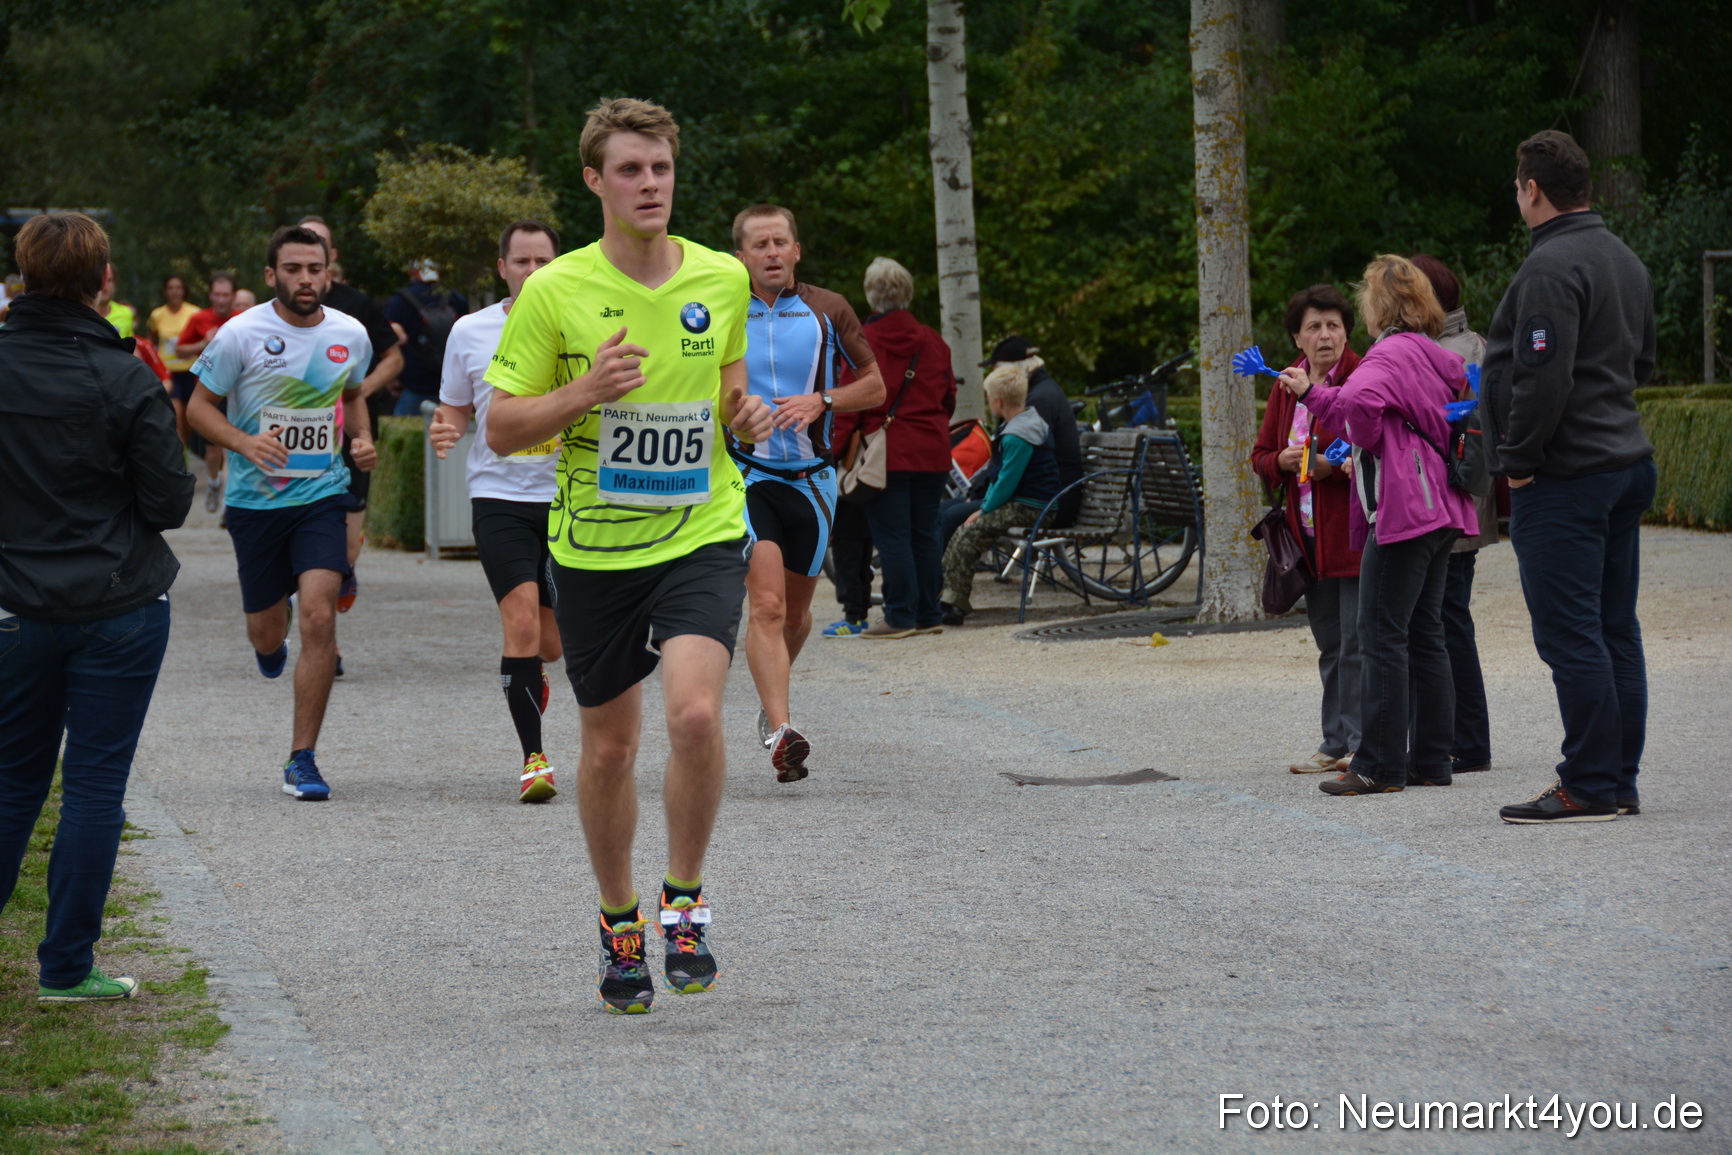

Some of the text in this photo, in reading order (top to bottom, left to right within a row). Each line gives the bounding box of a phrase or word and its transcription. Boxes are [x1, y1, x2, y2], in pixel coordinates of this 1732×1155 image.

[681, 337, 715, 350] Partl
[499, 355, 517, 371] Partl
[263, 411, 289, 422] PARTL
[604, 408, 699, 423] PARTL Neumarkt
[611, 426, 704, 466] 2005
[613, 473, 696, 492] Maximilian
